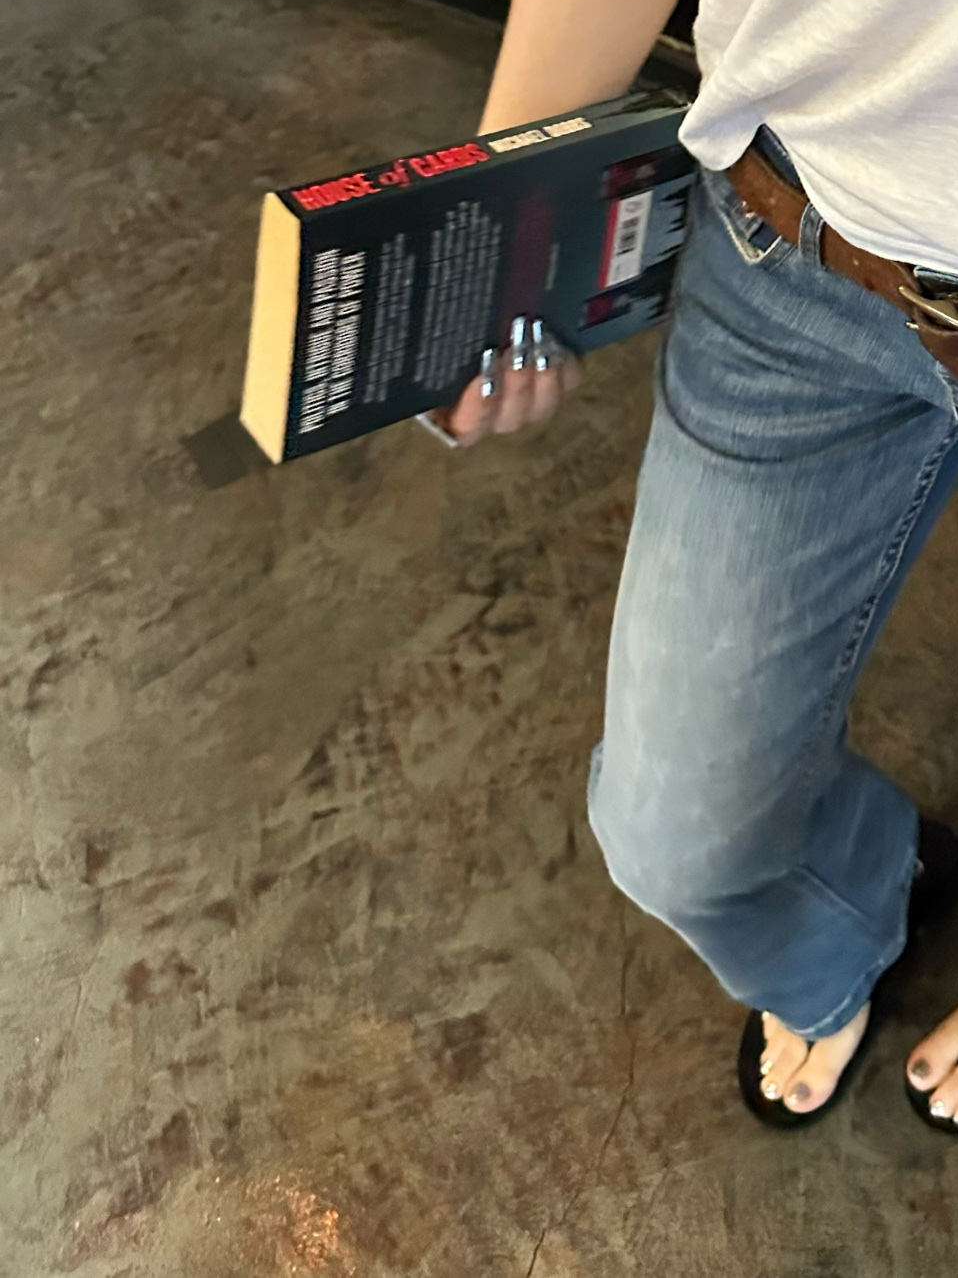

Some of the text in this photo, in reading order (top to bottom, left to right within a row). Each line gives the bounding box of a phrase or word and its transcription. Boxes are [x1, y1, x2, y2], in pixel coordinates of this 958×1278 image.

[293, 143, 492, 211] HOUSE of CARDS
[337, 251, 367, 299] POWER
